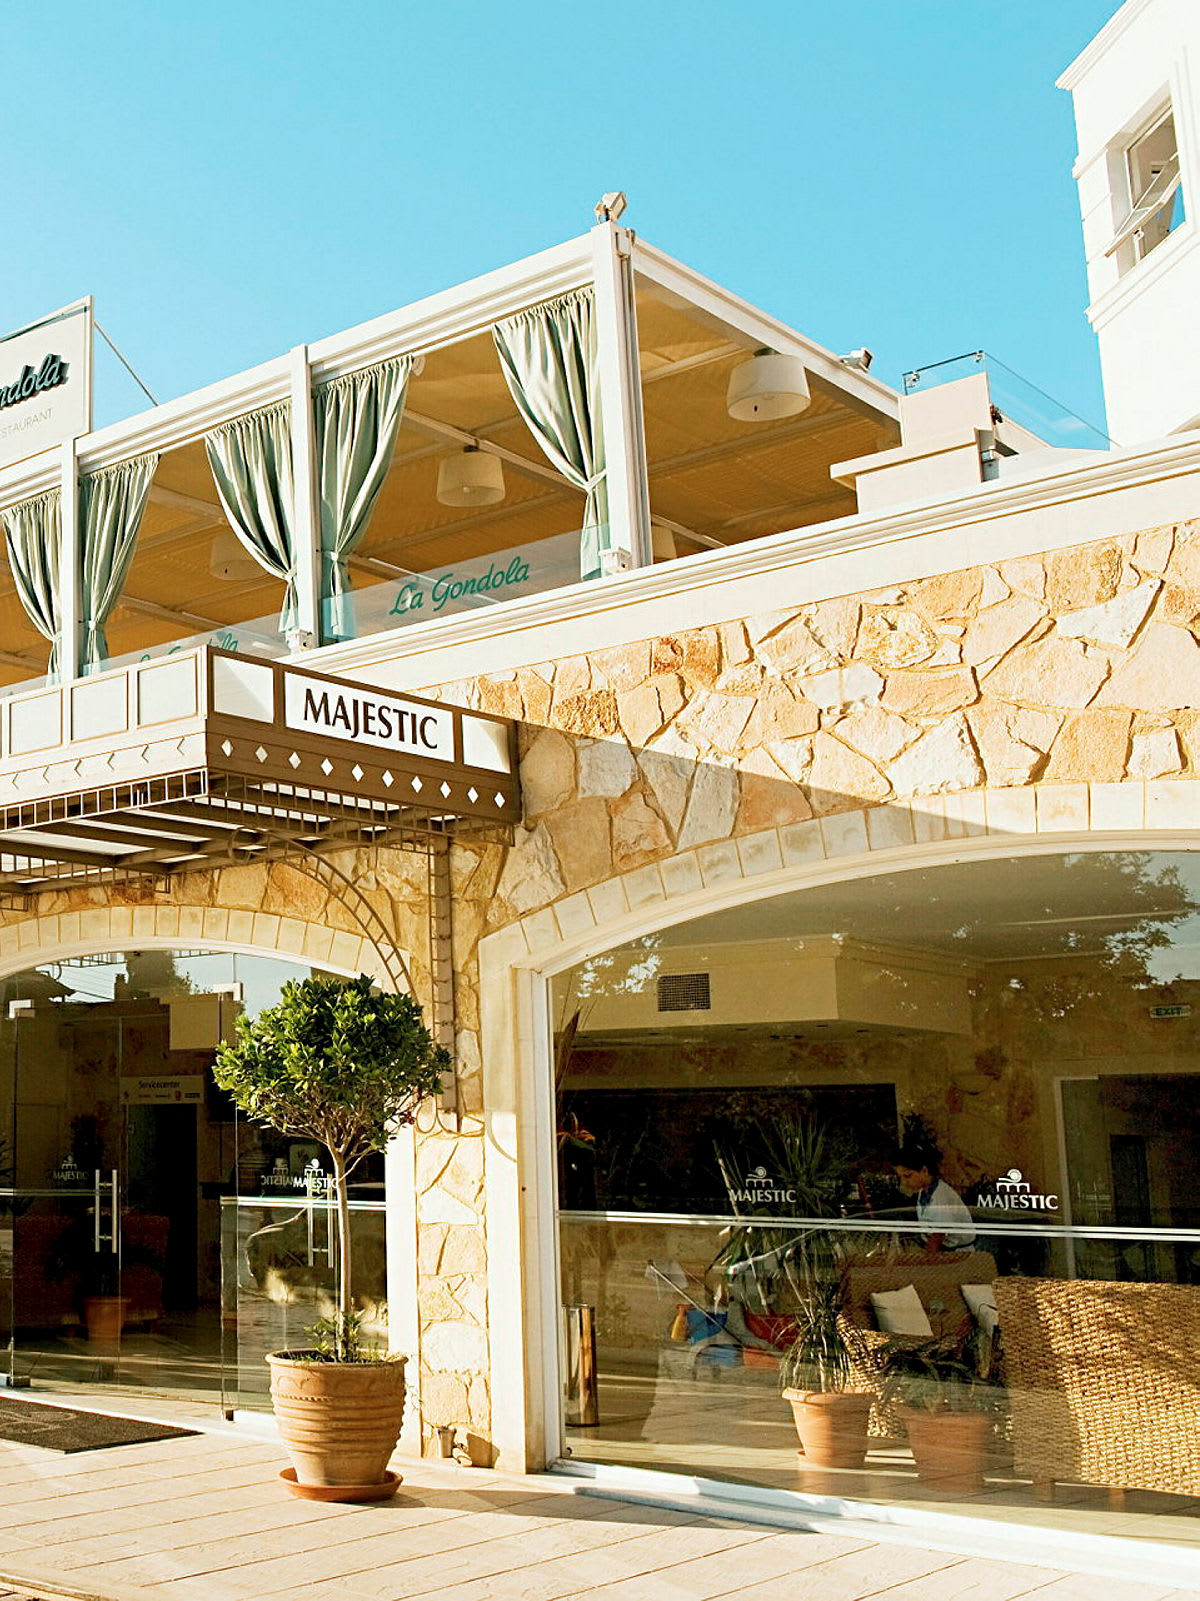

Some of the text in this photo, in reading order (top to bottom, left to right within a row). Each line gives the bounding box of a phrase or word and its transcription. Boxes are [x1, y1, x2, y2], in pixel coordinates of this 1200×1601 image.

[388, 556, 530, 615] La Gondola
[303, 687, 438, 750] MAJESTIC
[1155, 1006, 1182, 1016] EXIT
[728, 1188, 797, 1204] MAJESTIC
[977, 1194, 1059, 1211] MAJESTIC
